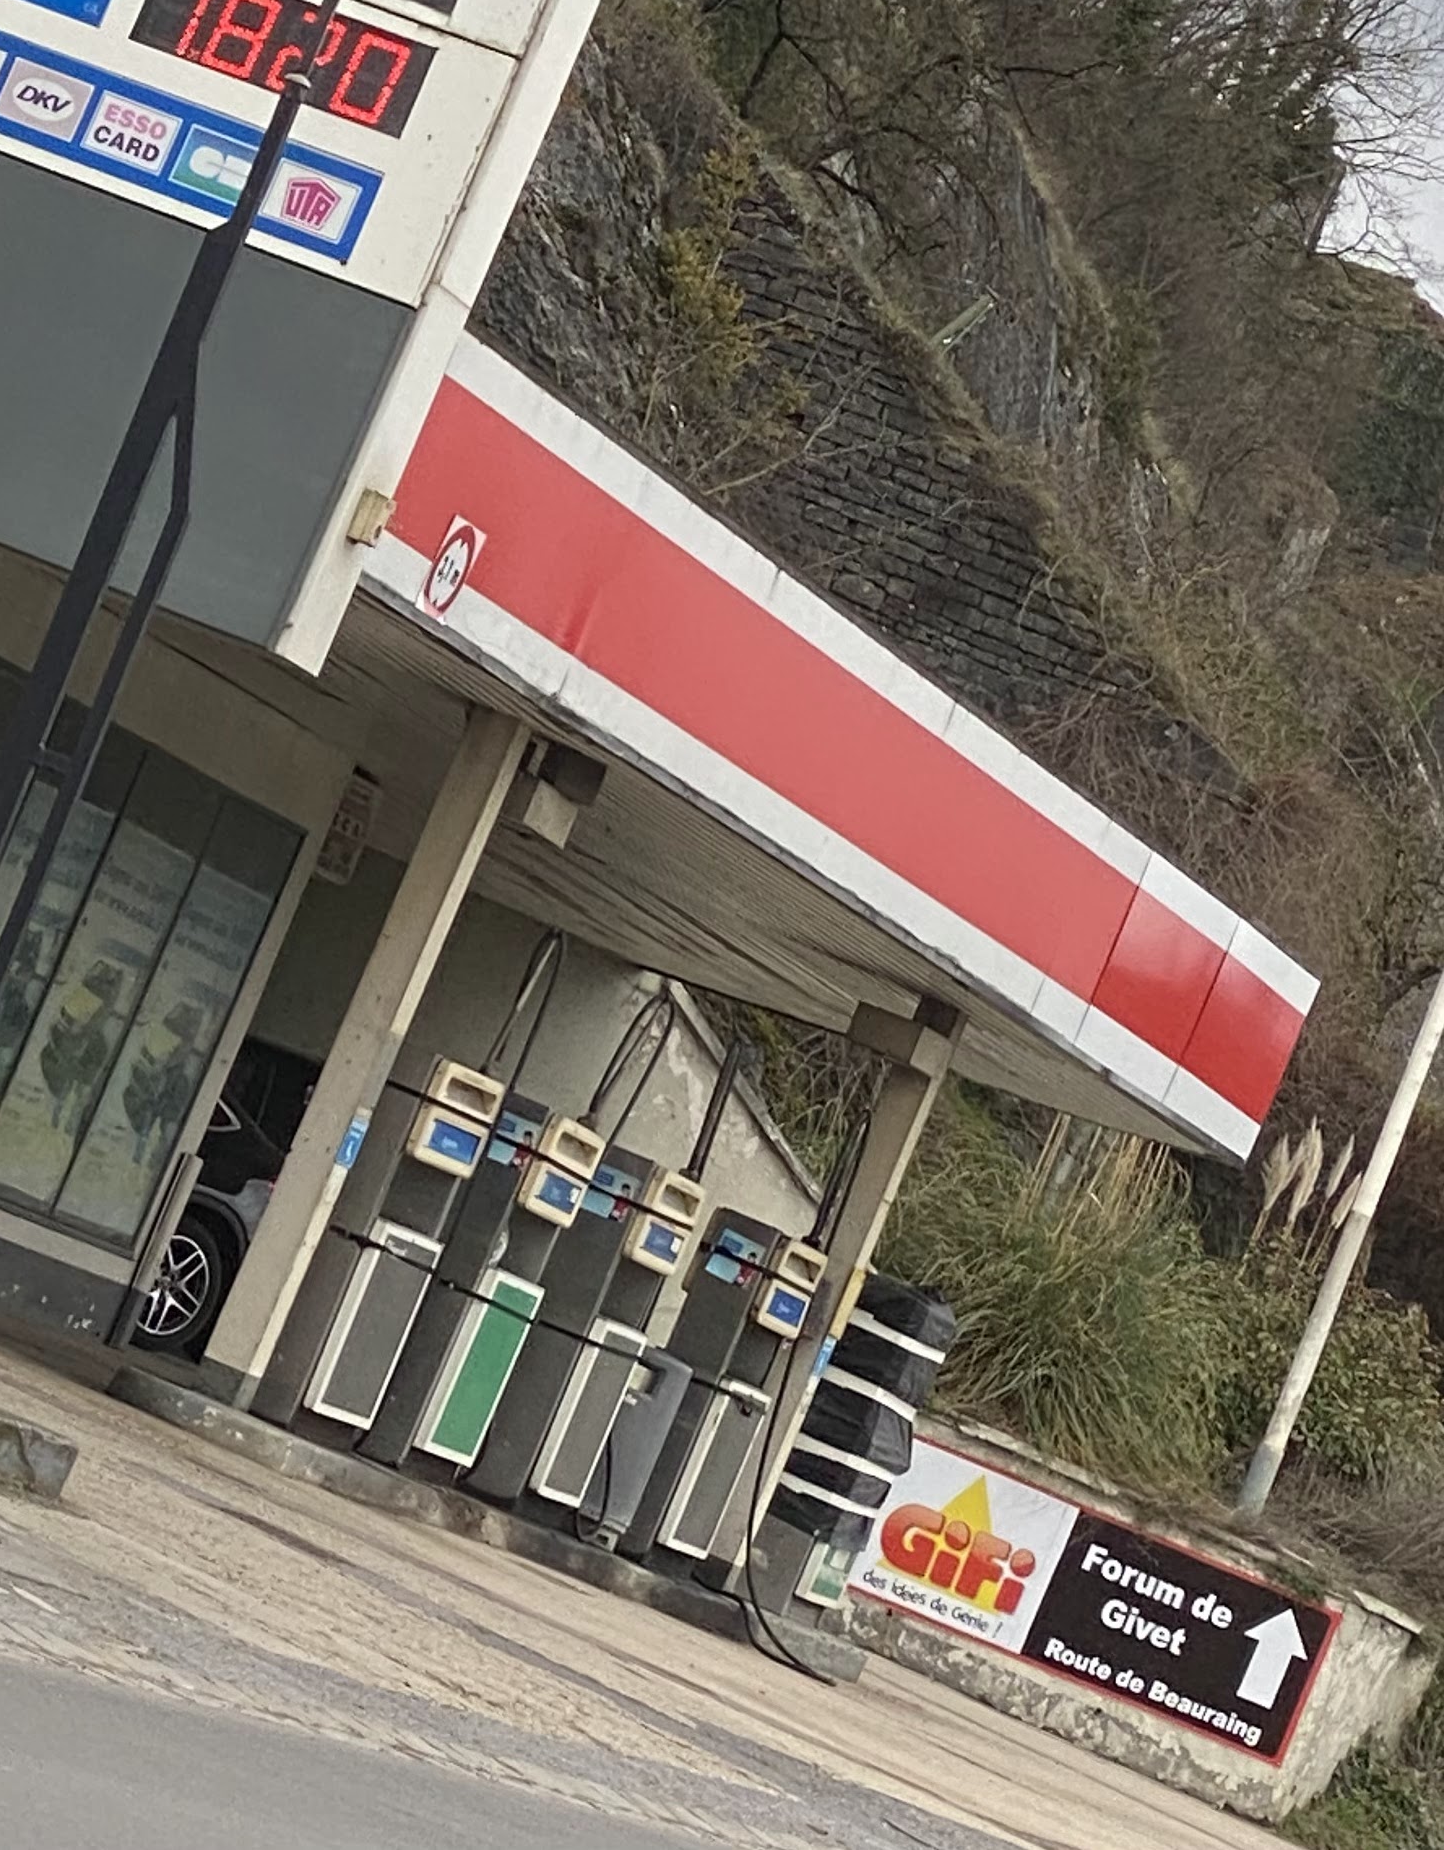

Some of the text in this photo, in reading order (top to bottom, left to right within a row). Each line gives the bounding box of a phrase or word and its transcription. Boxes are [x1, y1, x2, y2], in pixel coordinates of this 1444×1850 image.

[16, 85, 71, 113] DKV
[103, 102, 167, 141] ESSO
[93, 125, 160, 162] CARD
[283, 179, 339, 229] UTA
[862, 1568, 887, 1590] des
[930, 1595, 948, 1617] de
[1080, 1543, 1234, 1630] Forum de
[1100, 1599, 1187, 1657] Givet
[1043, 1637, 1263, 1748] Route de Beauraing
